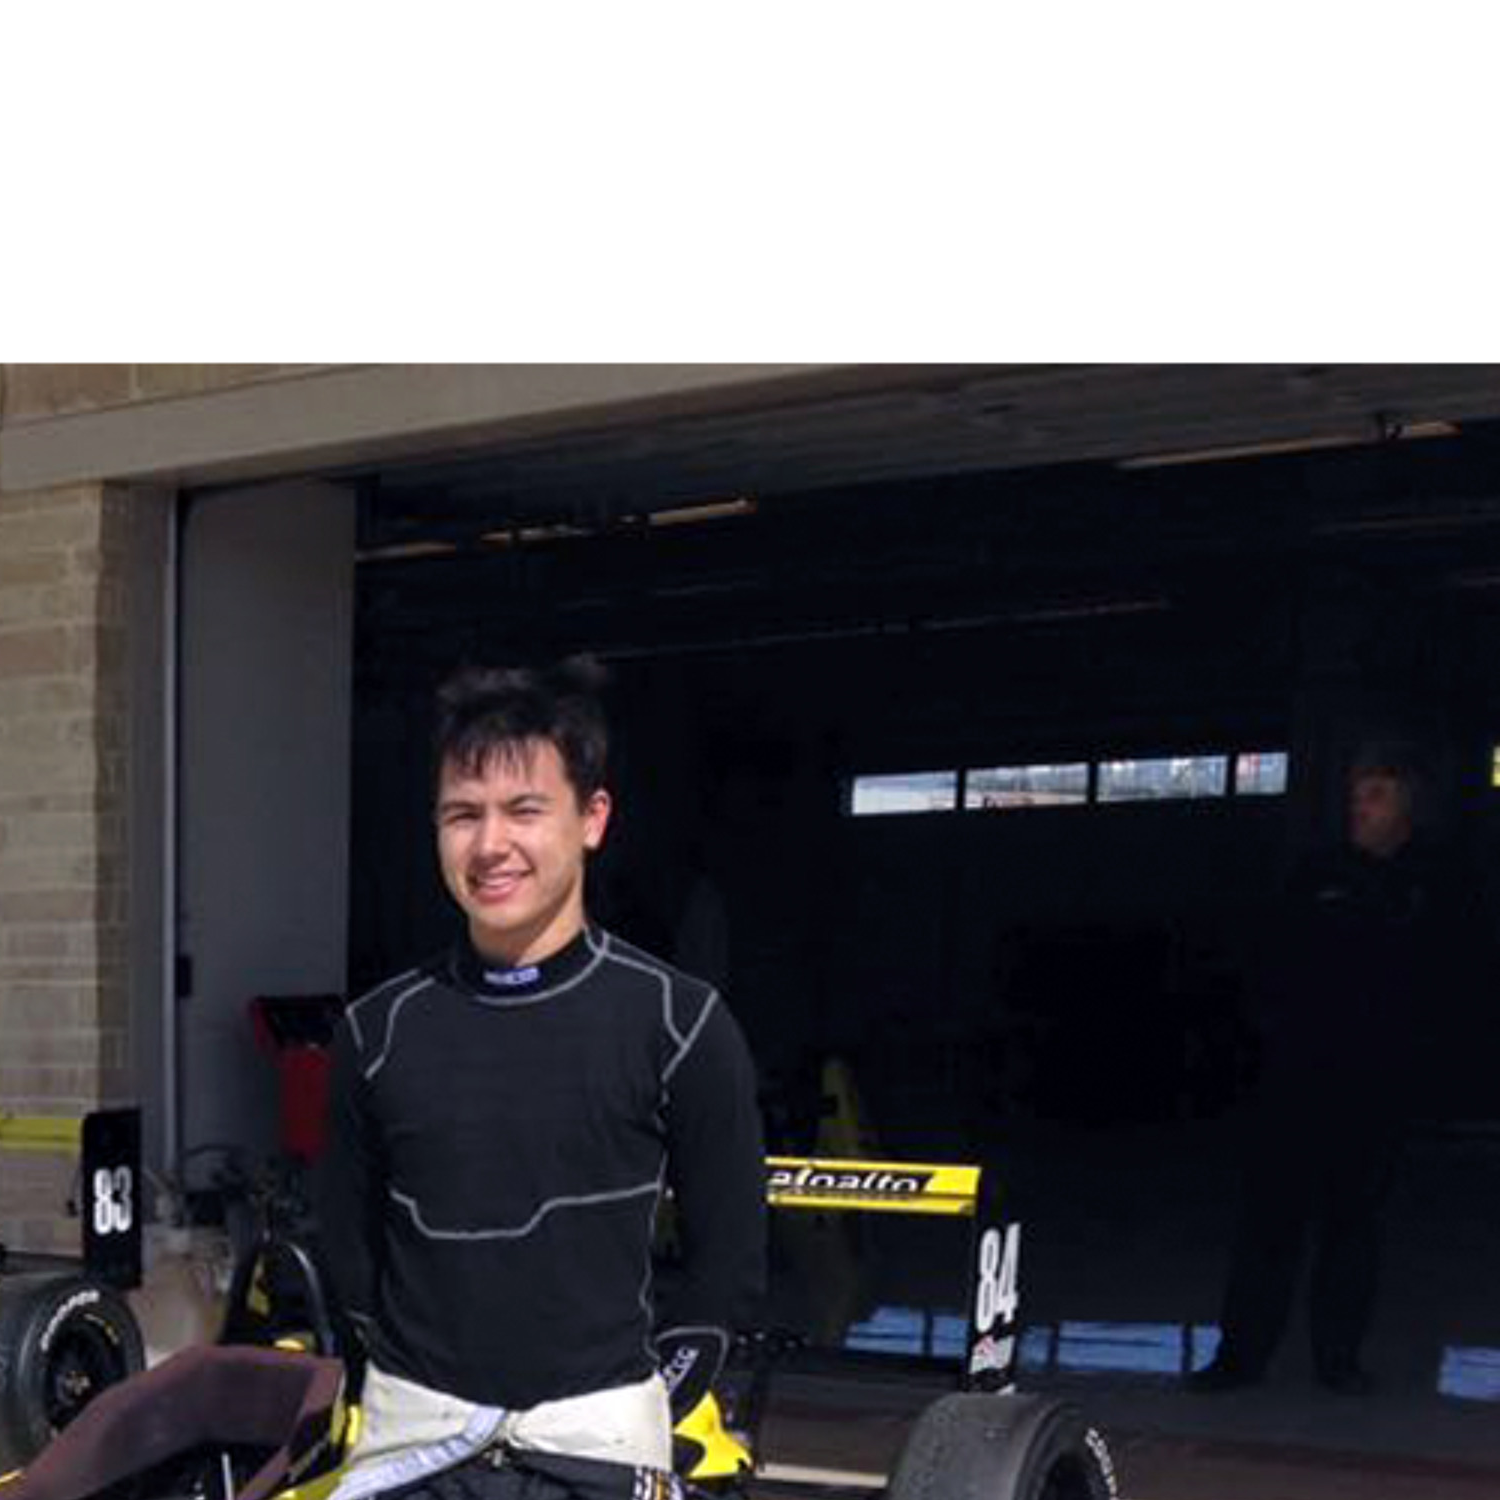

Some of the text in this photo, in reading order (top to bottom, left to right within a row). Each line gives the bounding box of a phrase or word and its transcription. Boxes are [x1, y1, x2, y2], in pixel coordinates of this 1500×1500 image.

[93, 1165, 133, 1235] 83
[767, 1163, 920, 1192] aloalto
[976, 1221, 1022, 1334] 84
